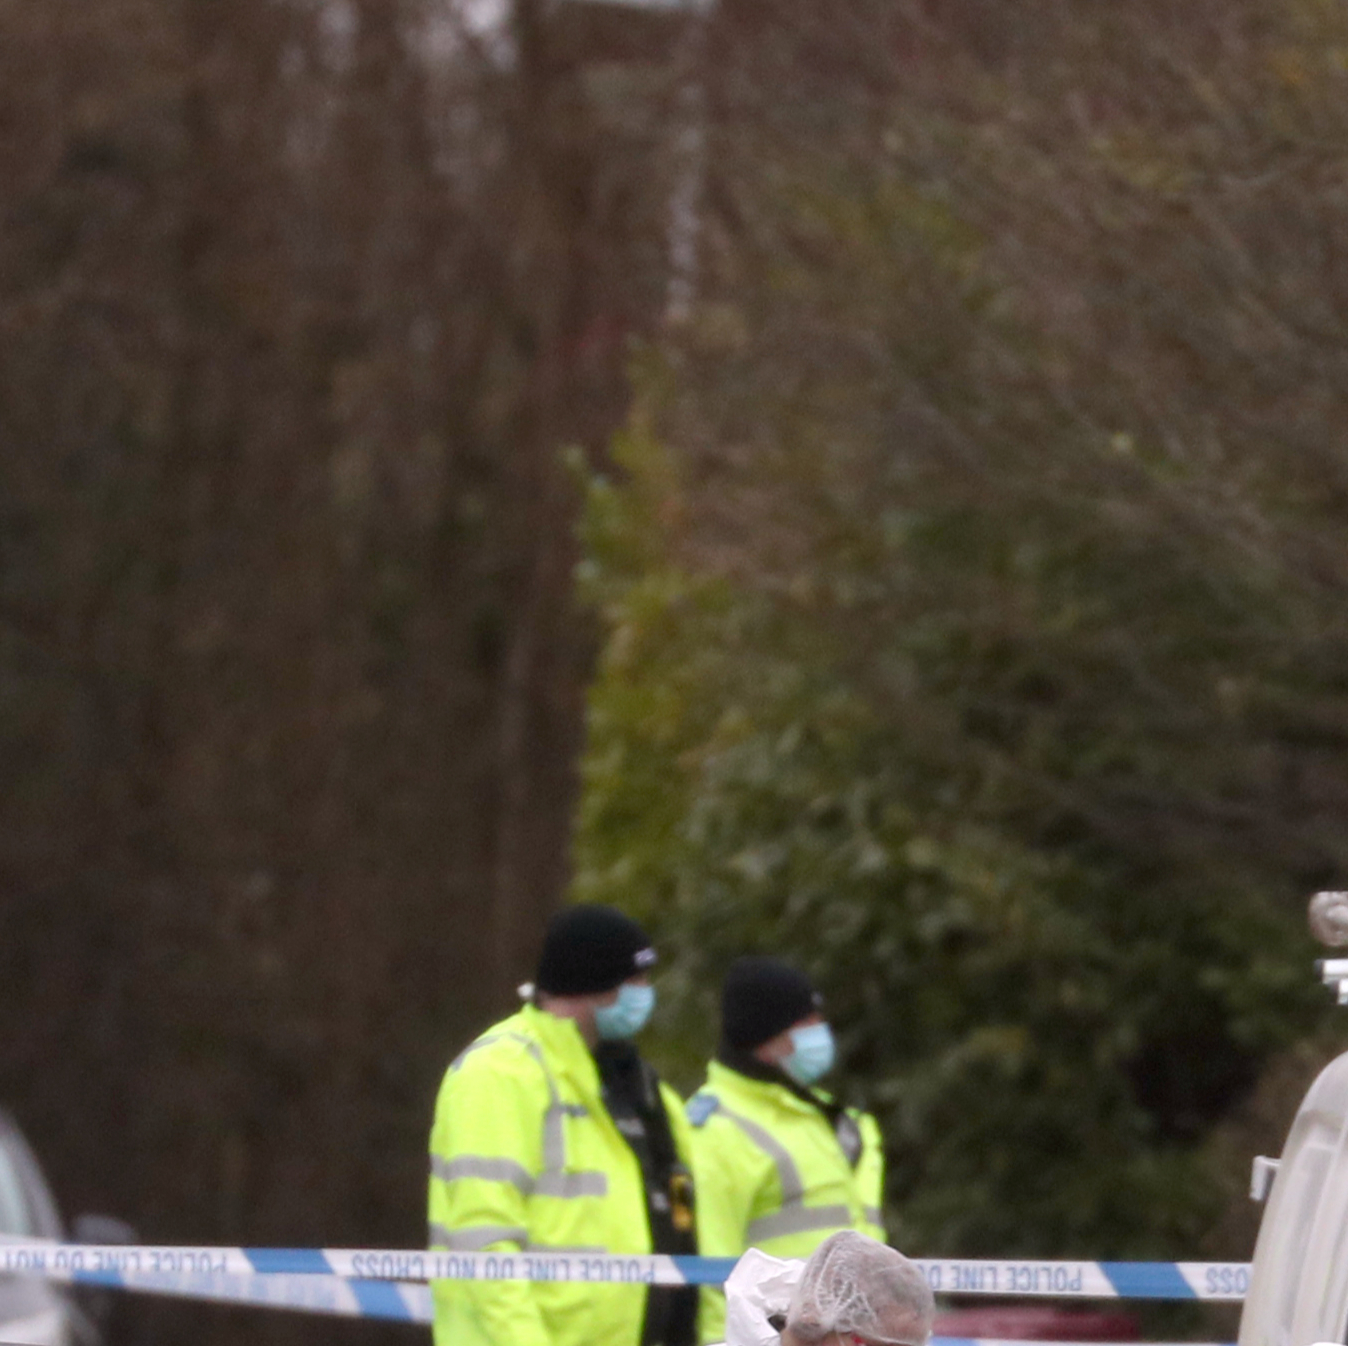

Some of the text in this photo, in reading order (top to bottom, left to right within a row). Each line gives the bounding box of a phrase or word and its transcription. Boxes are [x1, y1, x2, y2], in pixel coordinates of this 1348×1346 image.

[92, 1250, 142, 1271] LINE
[351, 1252, 656, 1282] POLICE LINE DO NOT CROSS
[950, 1265, 998, 1291] LINE
[1005, 1266, 1083, 1292] POLICE
